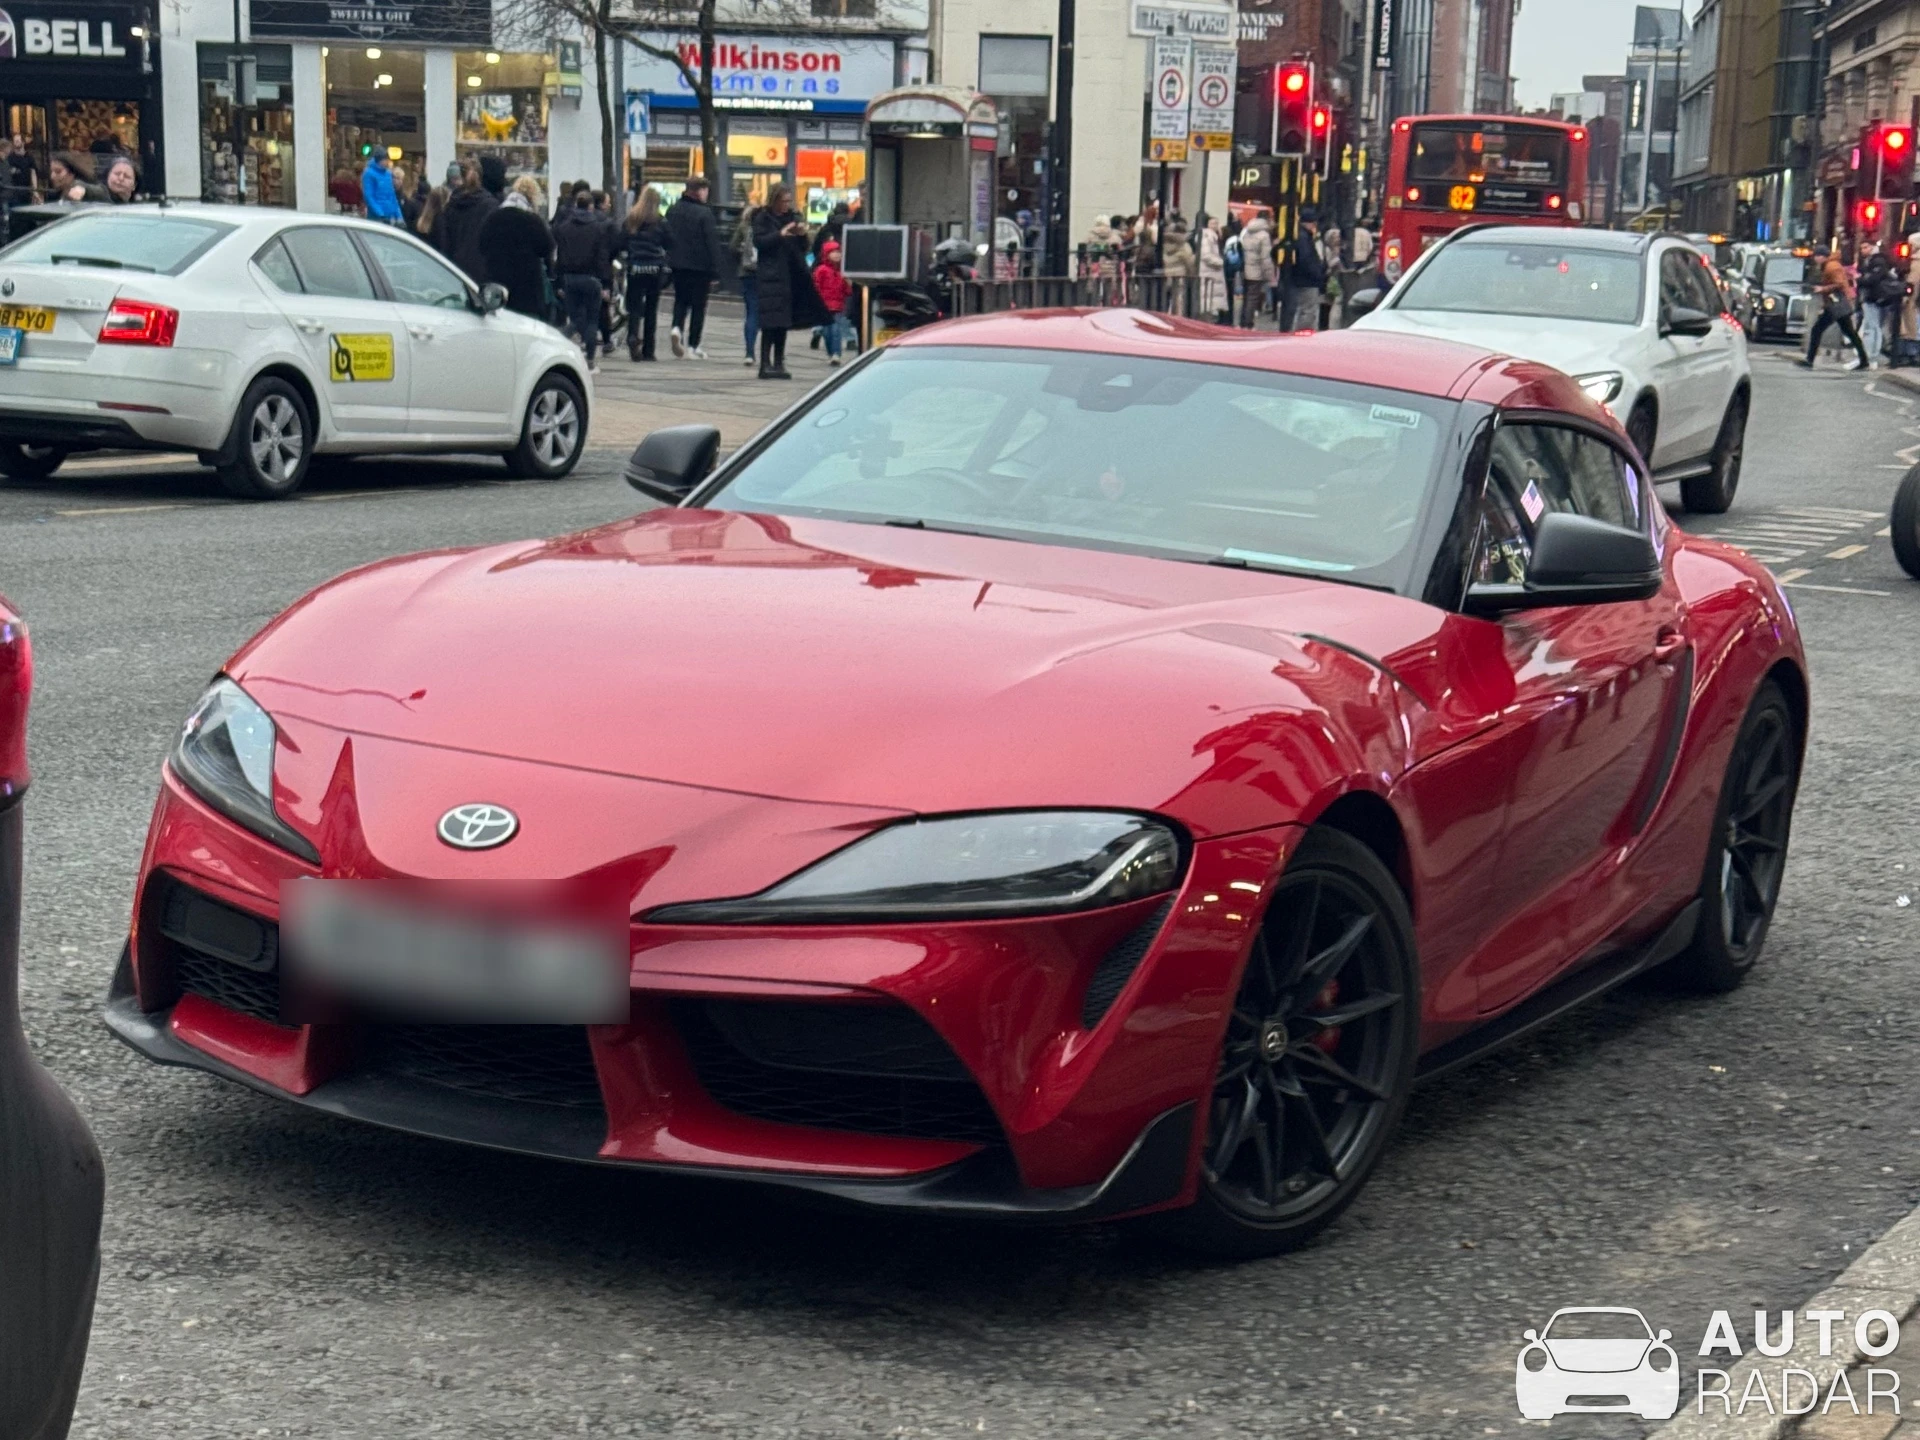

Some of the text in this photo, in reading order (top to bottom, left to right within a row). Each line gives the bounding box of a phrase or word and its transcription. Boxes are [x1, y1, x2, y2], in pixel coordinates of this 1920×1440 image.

[24, 19, 126, 56] BELL
[678, 42, 841, 73] Wilkinson
[1159, 55, 1184, 67] ZONE
[1201, 64, 1229, 75] ZONE
[678, 70, 840, 95] Cameras
[1450, 185, 1475, 211] 82
[0, 308, 47, 330] 8 PYO
